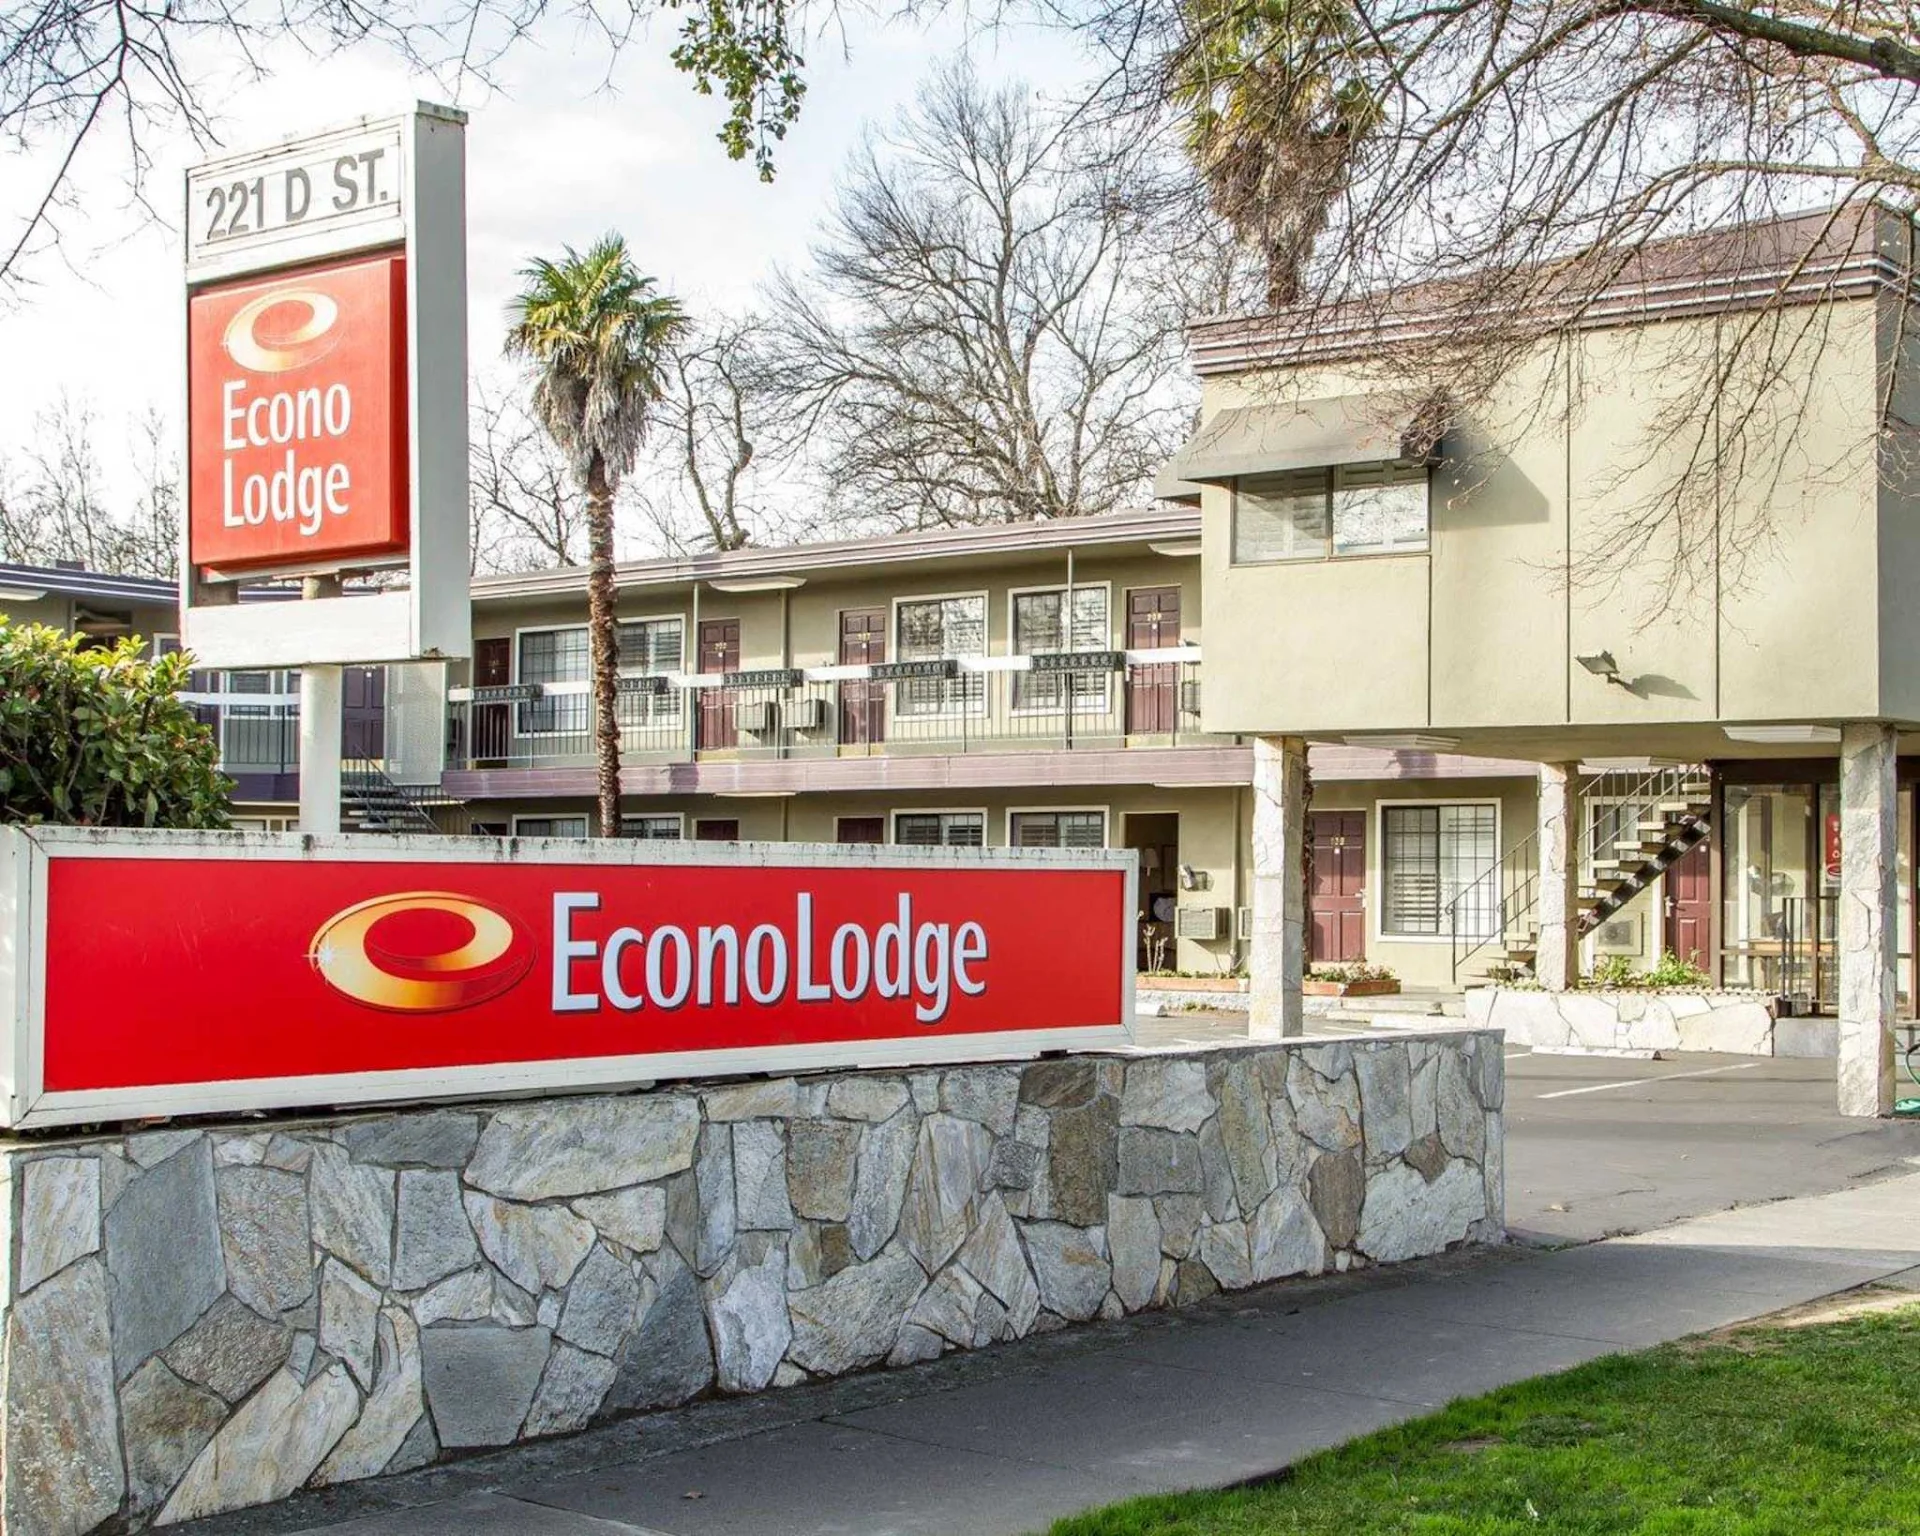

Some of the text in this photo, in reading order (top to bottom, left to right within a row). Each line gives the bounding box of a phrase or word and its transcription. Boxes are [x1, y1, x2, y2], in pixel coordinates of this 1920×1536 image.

[206, 148, 388, 240] 221 D ST.
[223, 379, 351, 451] Econo
[223, 450, 351, 536] Lodge
[551, 891, 989, 1023] EconoLodge
